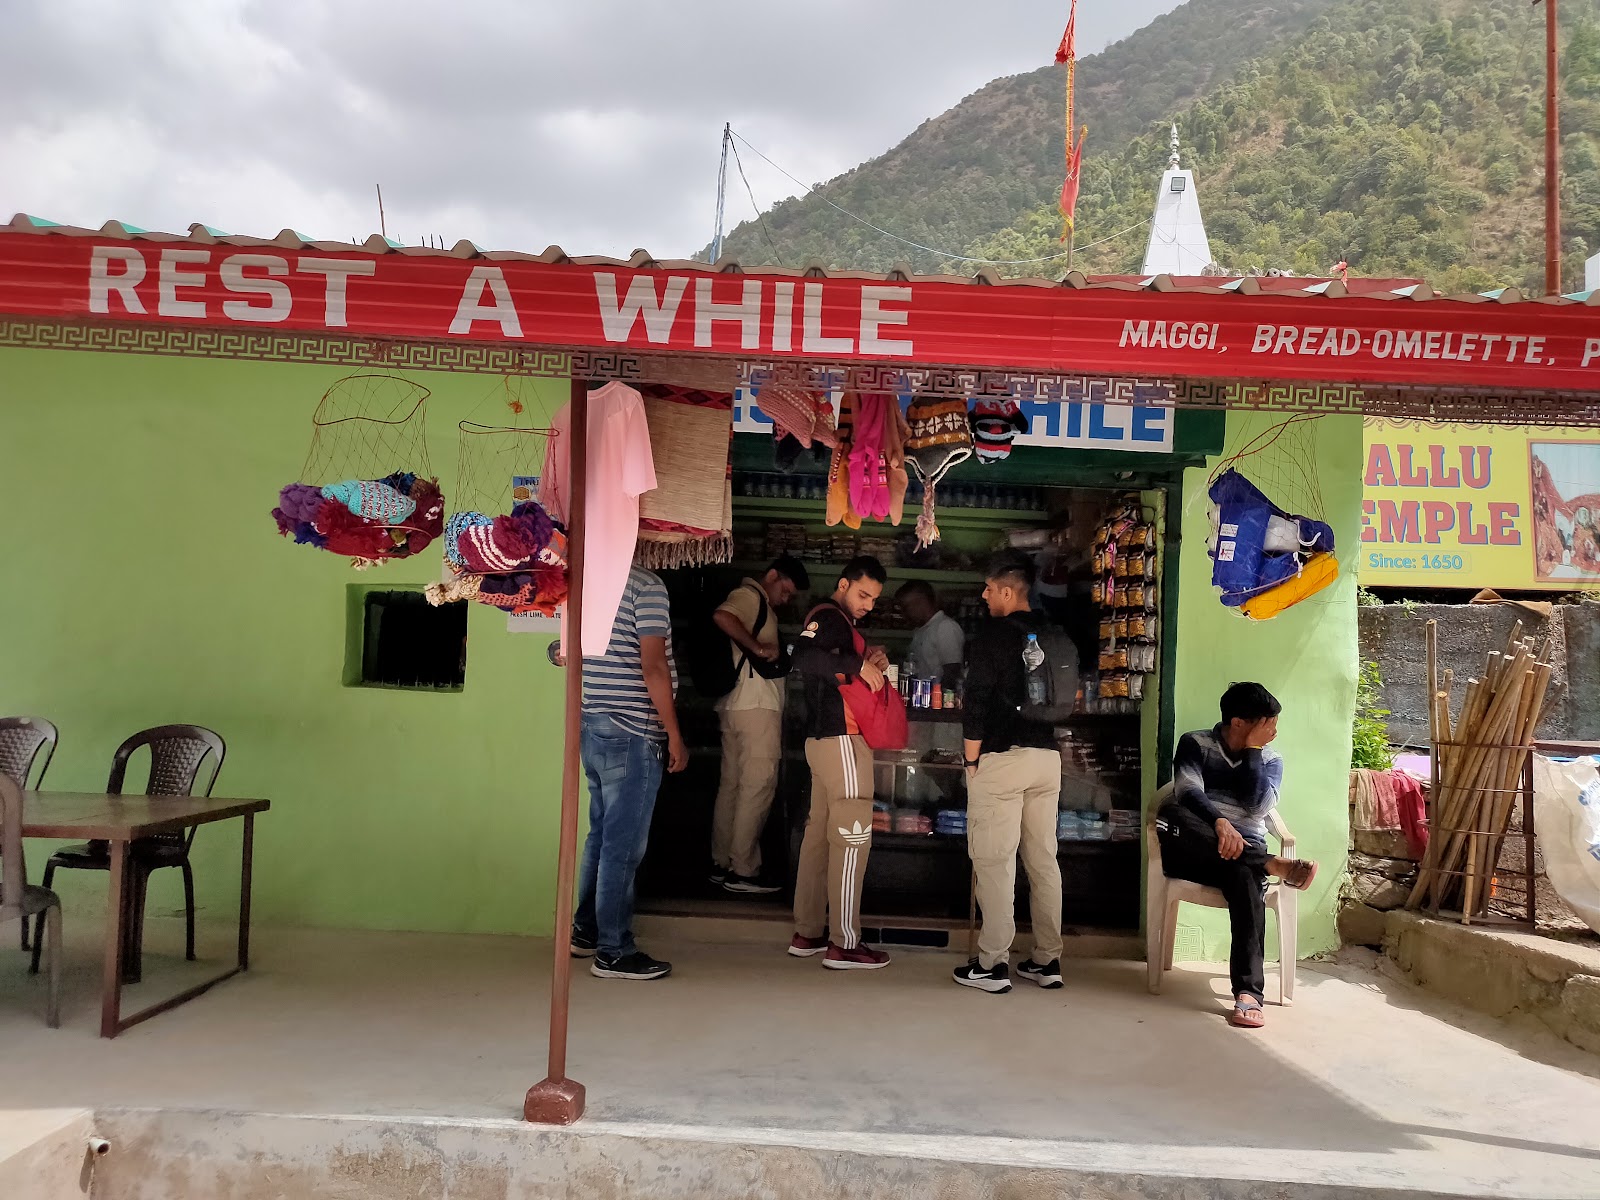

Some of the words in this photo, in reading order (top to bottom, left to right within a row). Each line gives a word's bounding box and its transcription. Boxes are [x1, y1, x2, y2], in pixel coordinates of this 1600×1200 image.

[89, 246, 376, 327] REST
[448, 266, 524, 338] A
[594, 271, 914, 357] WHILE
[1119, 319, 1228, 354] MAGGI,
[1251, 325, 1555, 366] BREAD-OMELETTE,
[968, 382, 1166, 442] HILE
[1364, 443, 1492, 489] ALLU
[1369, 553, 1417, 569] Since:
[1421, 555, 1463, 569] 1650
